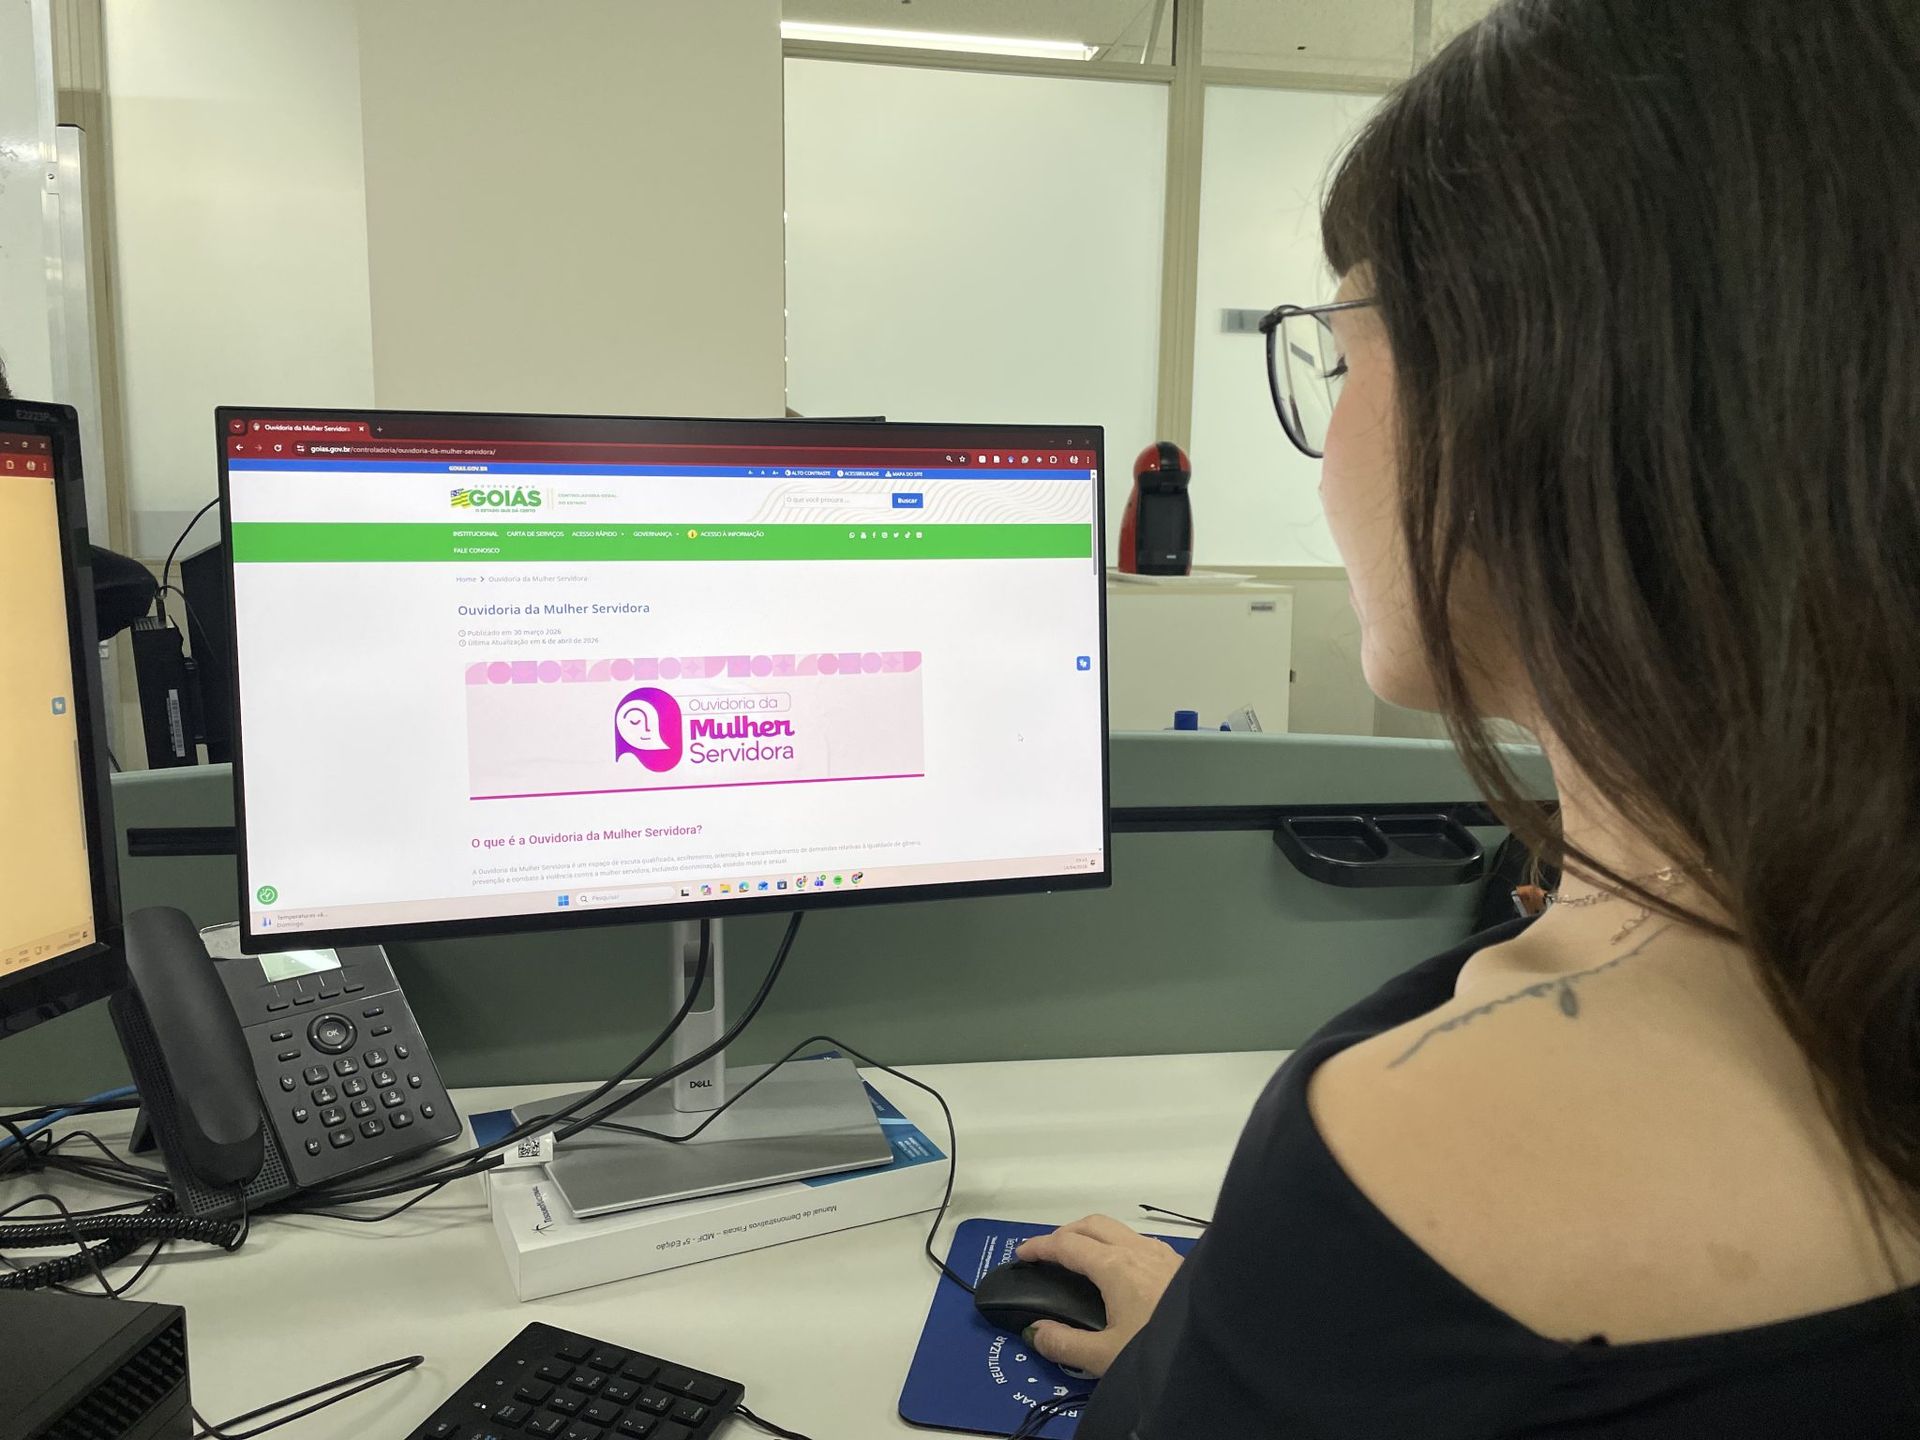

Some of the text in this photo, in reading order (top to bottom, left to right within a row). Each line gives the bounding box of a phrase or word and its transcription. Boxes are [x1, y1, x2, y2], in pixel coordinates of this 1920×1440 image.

[468, 487, 542, 507] GOIÁS
[458, 603, 650, 616] Ouvidoria da Mulher Servidora
[689, 696, 778, 711] Ouvidoria da
[690, 715, 795, 740] Mulher
[690, 740, 794, 764] Servidora
[471, 839, 480, 848] O
[484, 838, 505, 849] que
[508, 835, 516, 846] é
[528, 832, 583, 845] Ouvidoria
[586, 830, 600, 841] da
[603, 827, 641, 840] Mulher
[645, 824, 702, 838] Servidora?
[690, 1080, 712, 1088] DELL
[812, 1205, 837, 1217] Manual
[749, 1212, 801, 1229] Demonstrativos
[699, 1232, 715, 1242] MDF
[723, 1224, 747, 1235] Fiscais
[656, 1240, 681, 1250] Edição
[988, 1335, 1008, 1384] REUTILIZAR
